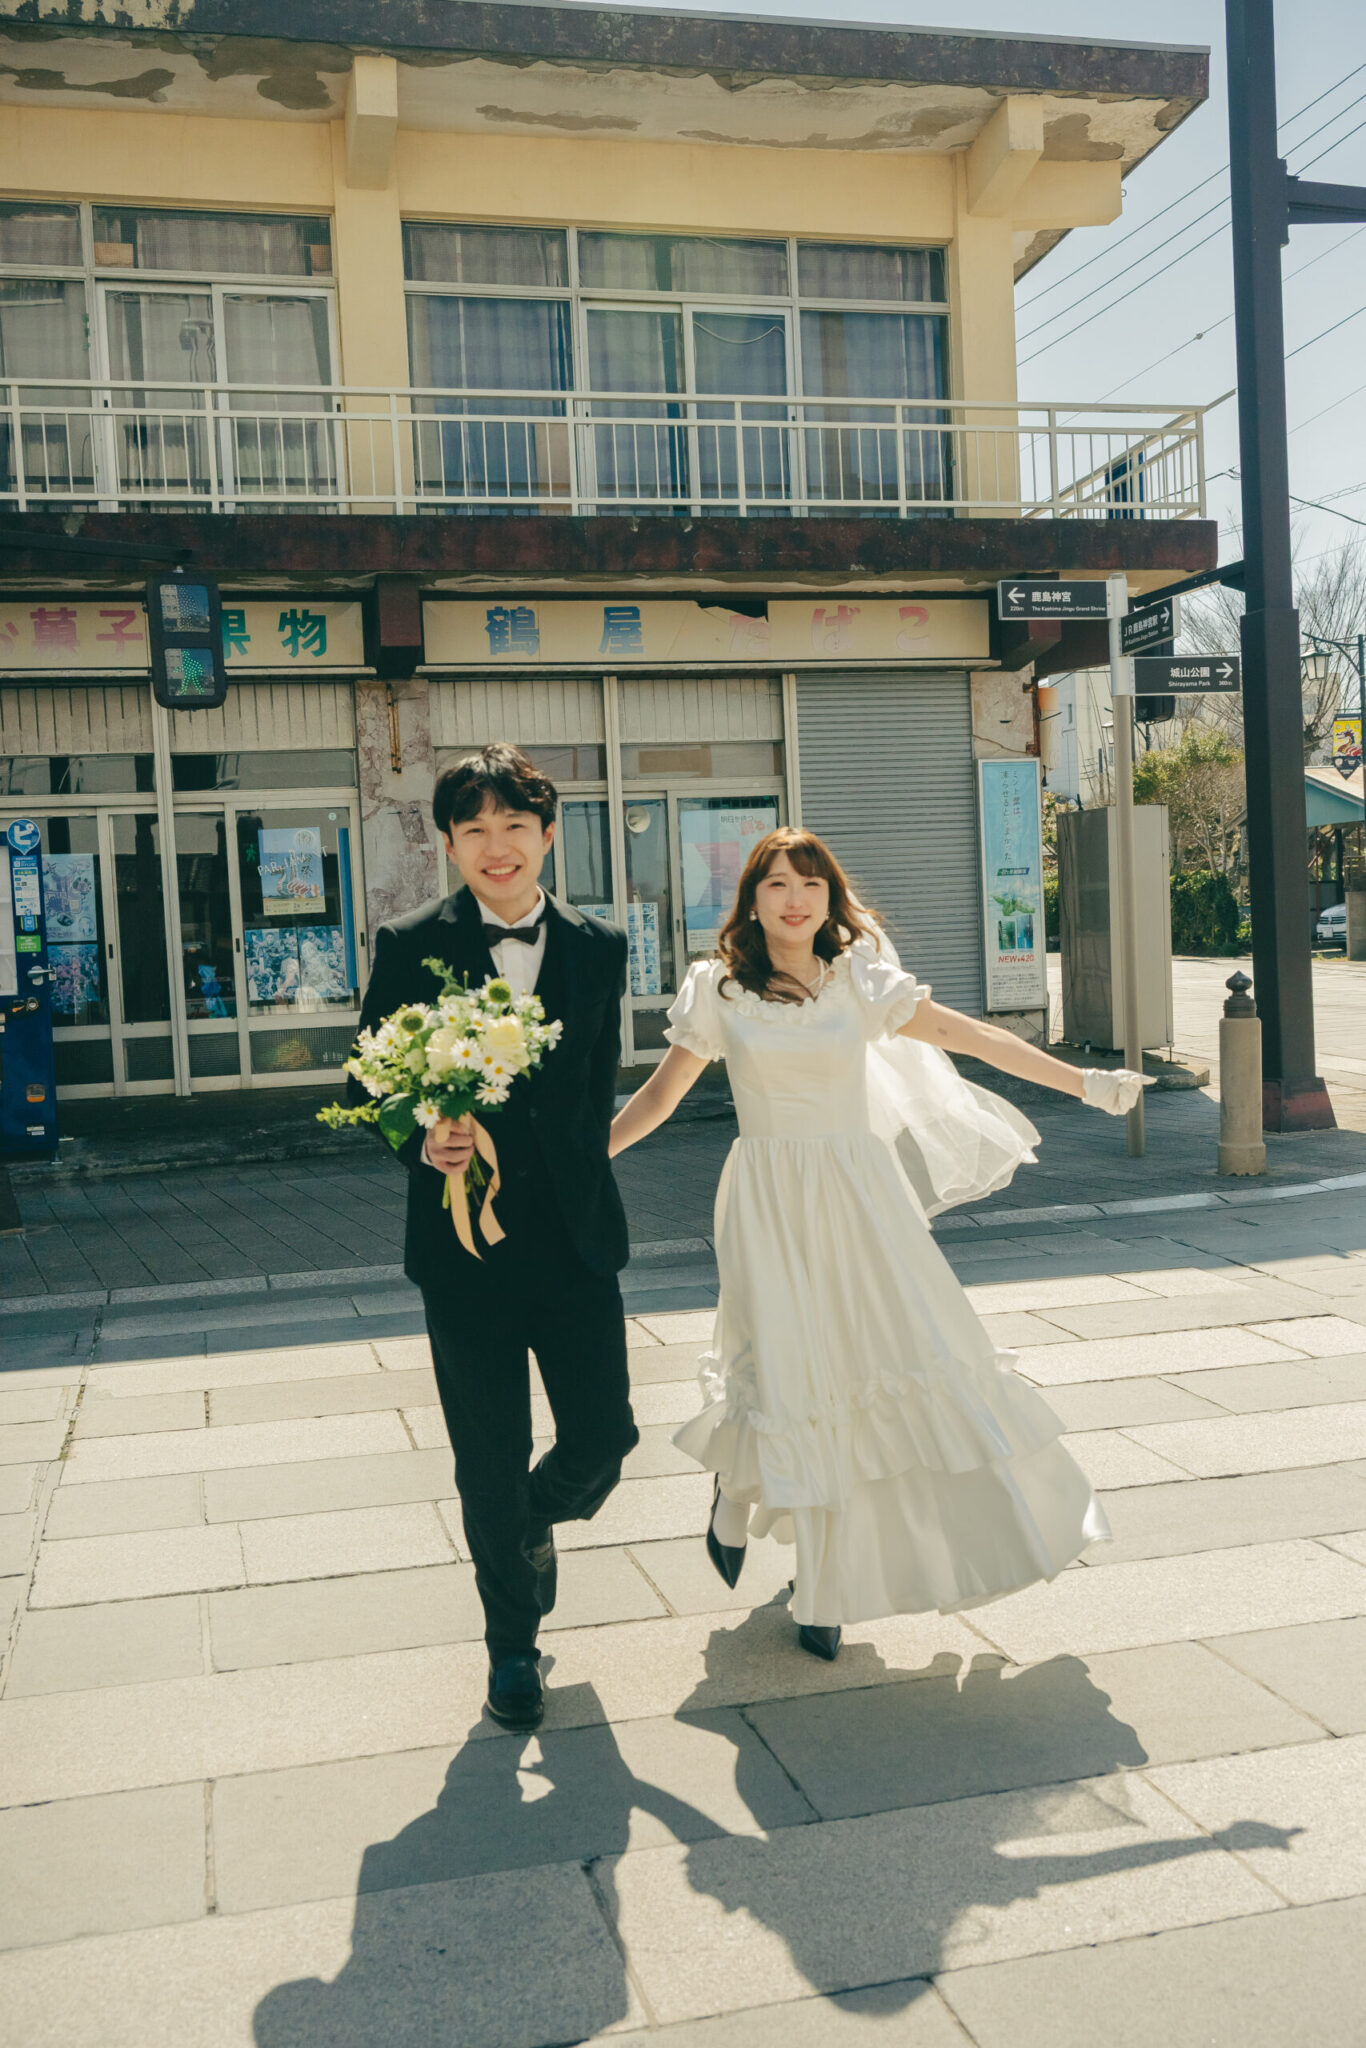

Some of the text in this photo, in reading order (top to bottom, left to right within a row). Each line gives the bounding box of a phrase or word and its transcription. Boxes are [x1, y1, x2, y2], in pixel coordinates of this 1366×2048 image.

[1031, 591, 1072, 603] 鹿島神宮
[220, 608, 327, 658] 果物
[485, 606, 644, 655] 鶴屋
[1170, 666, 1210, 679] 城山公園
[998, 955, 1017, 963] NEW
